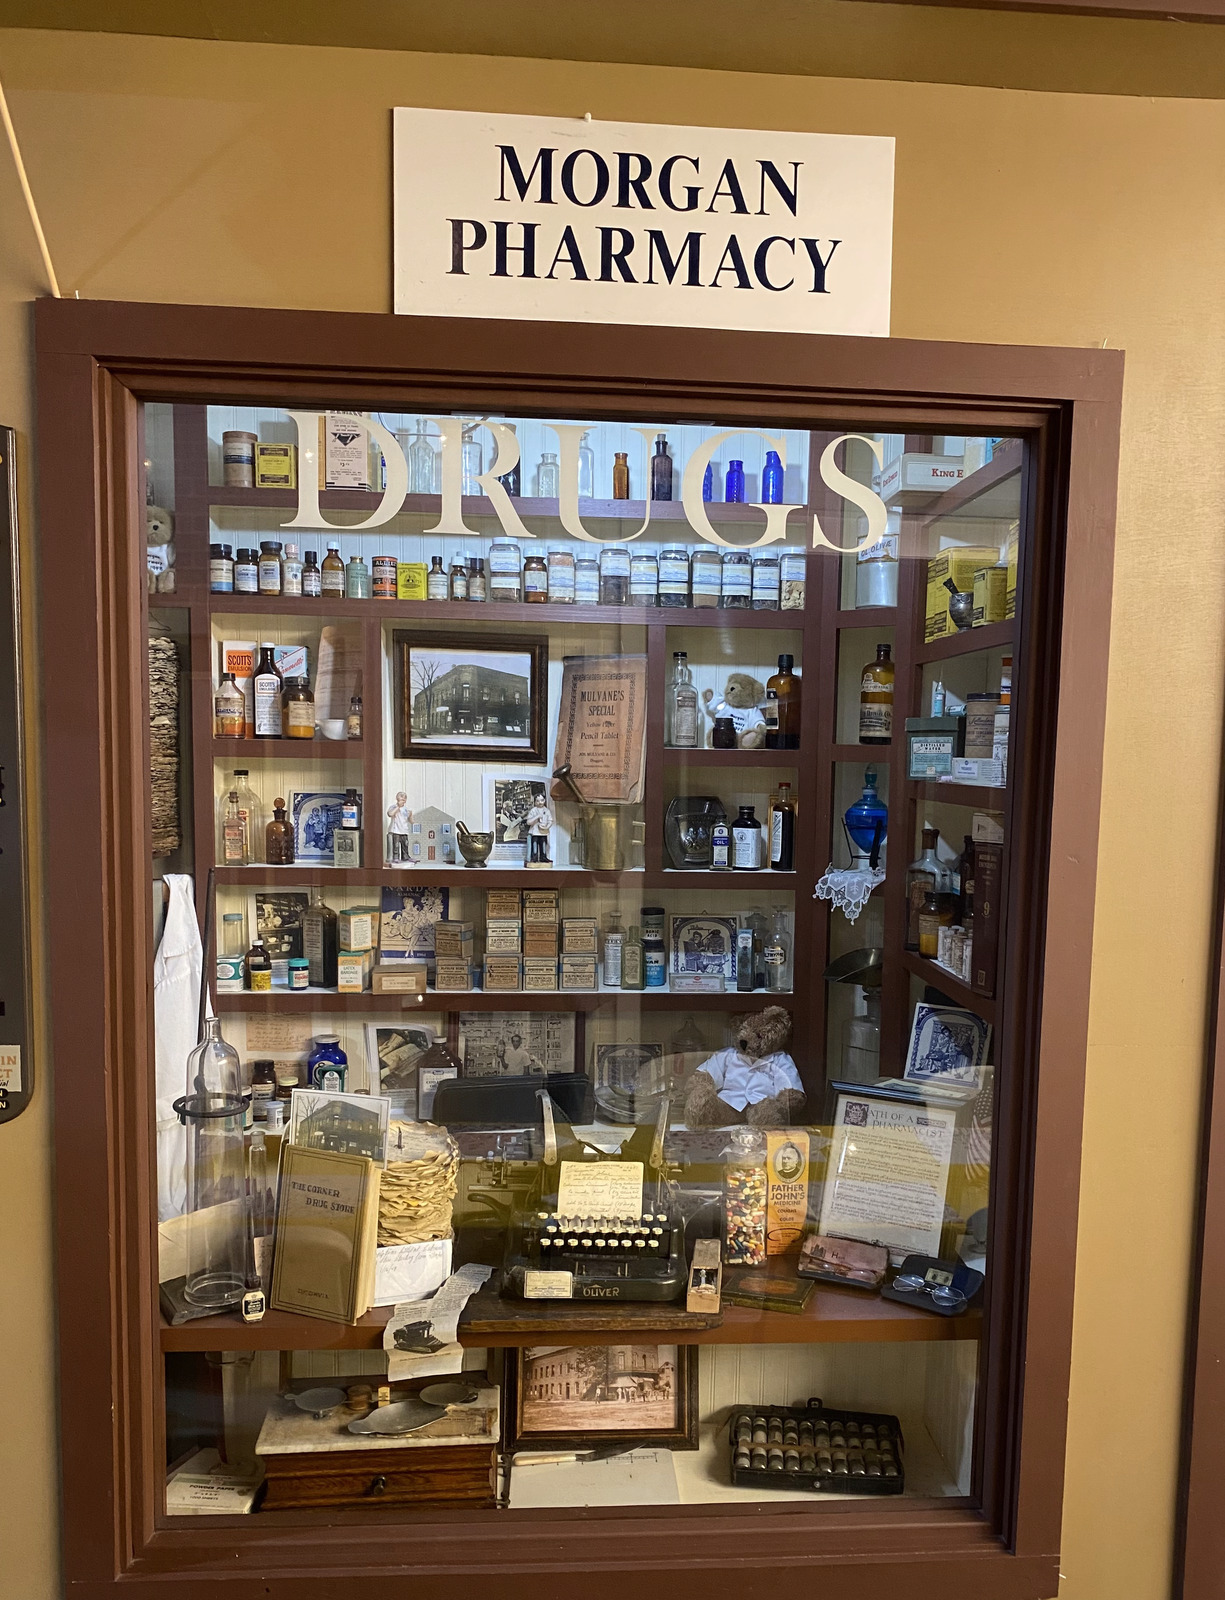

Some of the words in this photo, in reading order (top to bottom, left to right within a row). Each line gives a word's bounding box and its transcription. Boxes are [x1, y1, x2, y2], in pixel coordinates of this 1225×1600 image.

[494, 144, 804, 217] MORGAN
[446, 218, 842, 294] PHARMACY
[280, 410, 888, 553] DRUGS
[227, 655, 252, 666] SCOTT'S
[580, 690, 625, 702] MULVANE'S
[588, 704, 616, 717] SPECIAL
[580, 732, 599, 740] Pencil
[600, 731, 619, 739] Tablet
[890, 1112, 904, 1121] OF
[906, 1115, 914, 1123] A
[872, 1120, 946, 1139] PHARMACIST
[291, 1181, 306, 1192] THE
[306, 1184, 341, 1198] CORNER
[771, 1184, 804, 1192] FATHER
[770, 1192, 805, 1201] JOHN'S
[305, 1197, 329, 1209] DRUG
[330, 1202, 355, 1214] STORE
[583, 1284, 620, 1297] OLIVER
